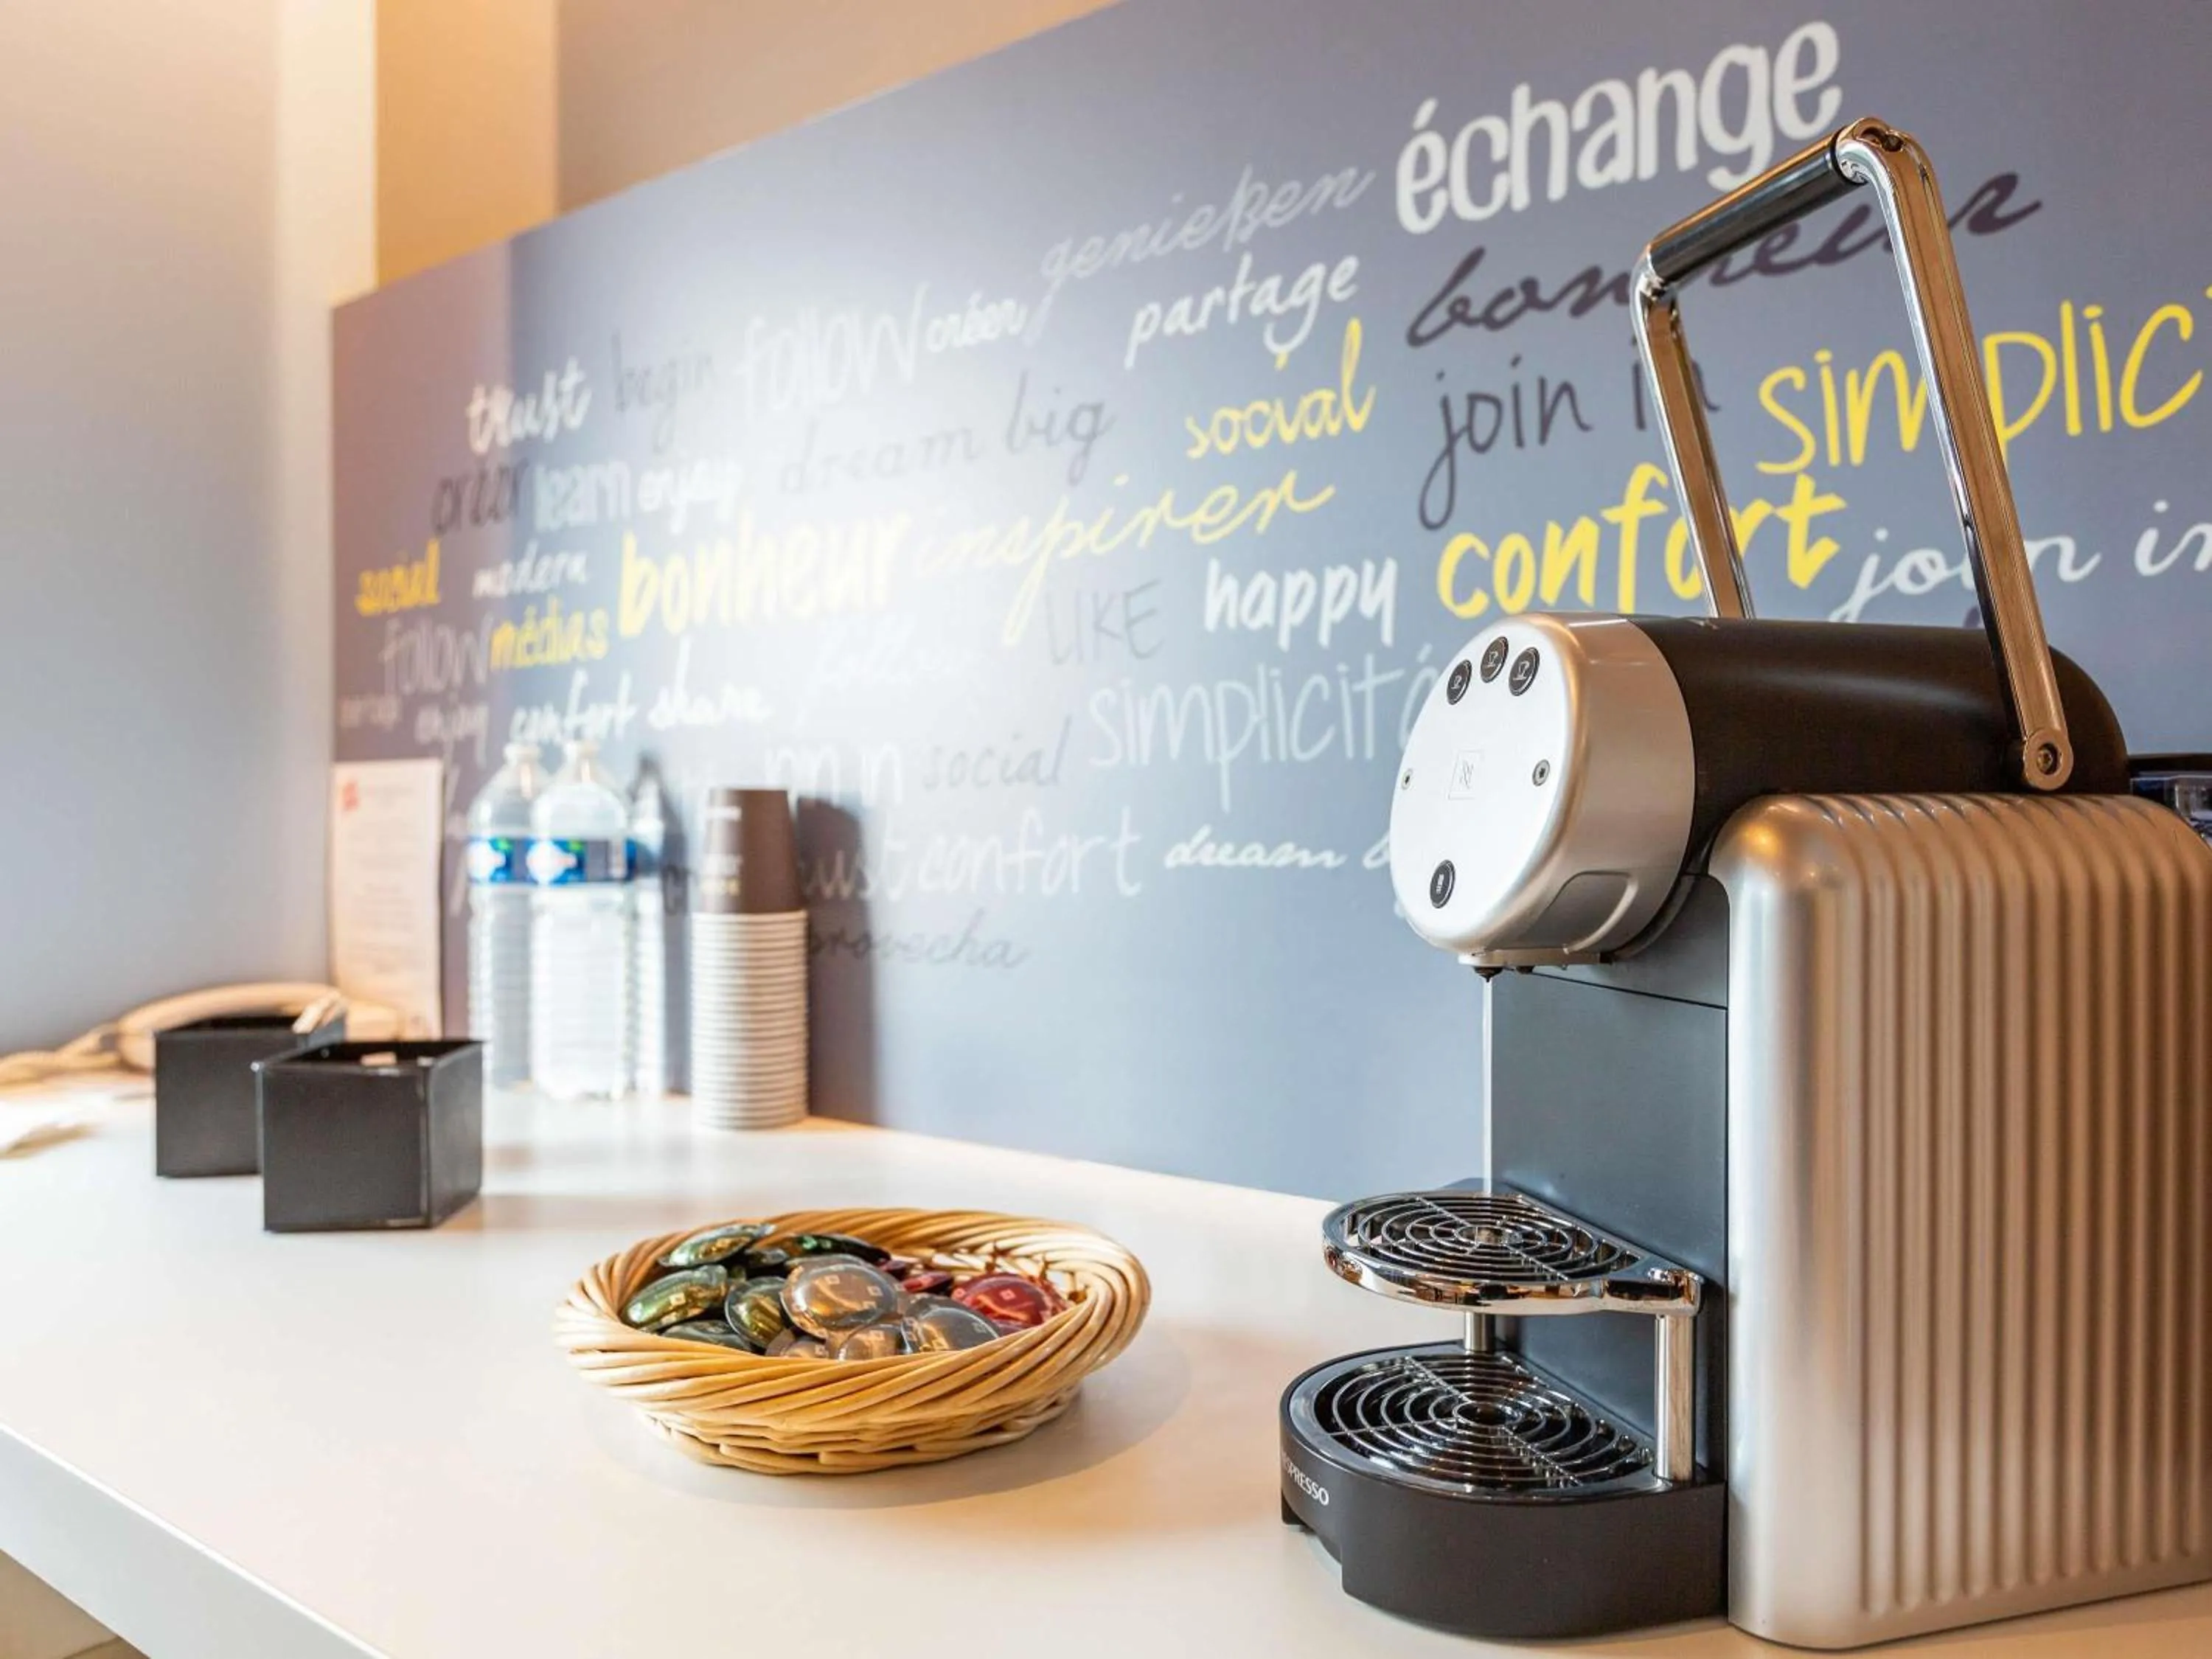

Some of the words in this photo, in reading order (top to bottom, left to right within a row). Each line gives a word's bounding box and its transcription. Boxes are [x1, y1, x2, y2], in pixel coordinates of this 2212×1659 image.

[1395, 21, 1842, 234] échange
[1124, 251, 1360, 369] partage
[1405, 173, 2042, 348] boneur
[465, 355, 592, 456] trust
[777, 414, 982, 495] dream
[1004, 369, 1119, 485] big
[1185, 317, 1376, 459] social
[1755, 283, 2212, 475] simplic
[1419, 354, 1593, 531] join
[618, 509, 913, 639] bonheur
[913, 470, 1336, 647] inspirer
[1437, 461, 1848, 619] confort
[1827, 525, 2101, 624] jon
[1042, 577, 1166, 666] LIKE
[1204, 557, 1399, 652] happy
[922, 714, 1073, 789] social
[917, 807, 1143, 898] confort
[1163, 823, 1349, 870] dream
[1283, 1452, 1329, 1506] SPRESSO
